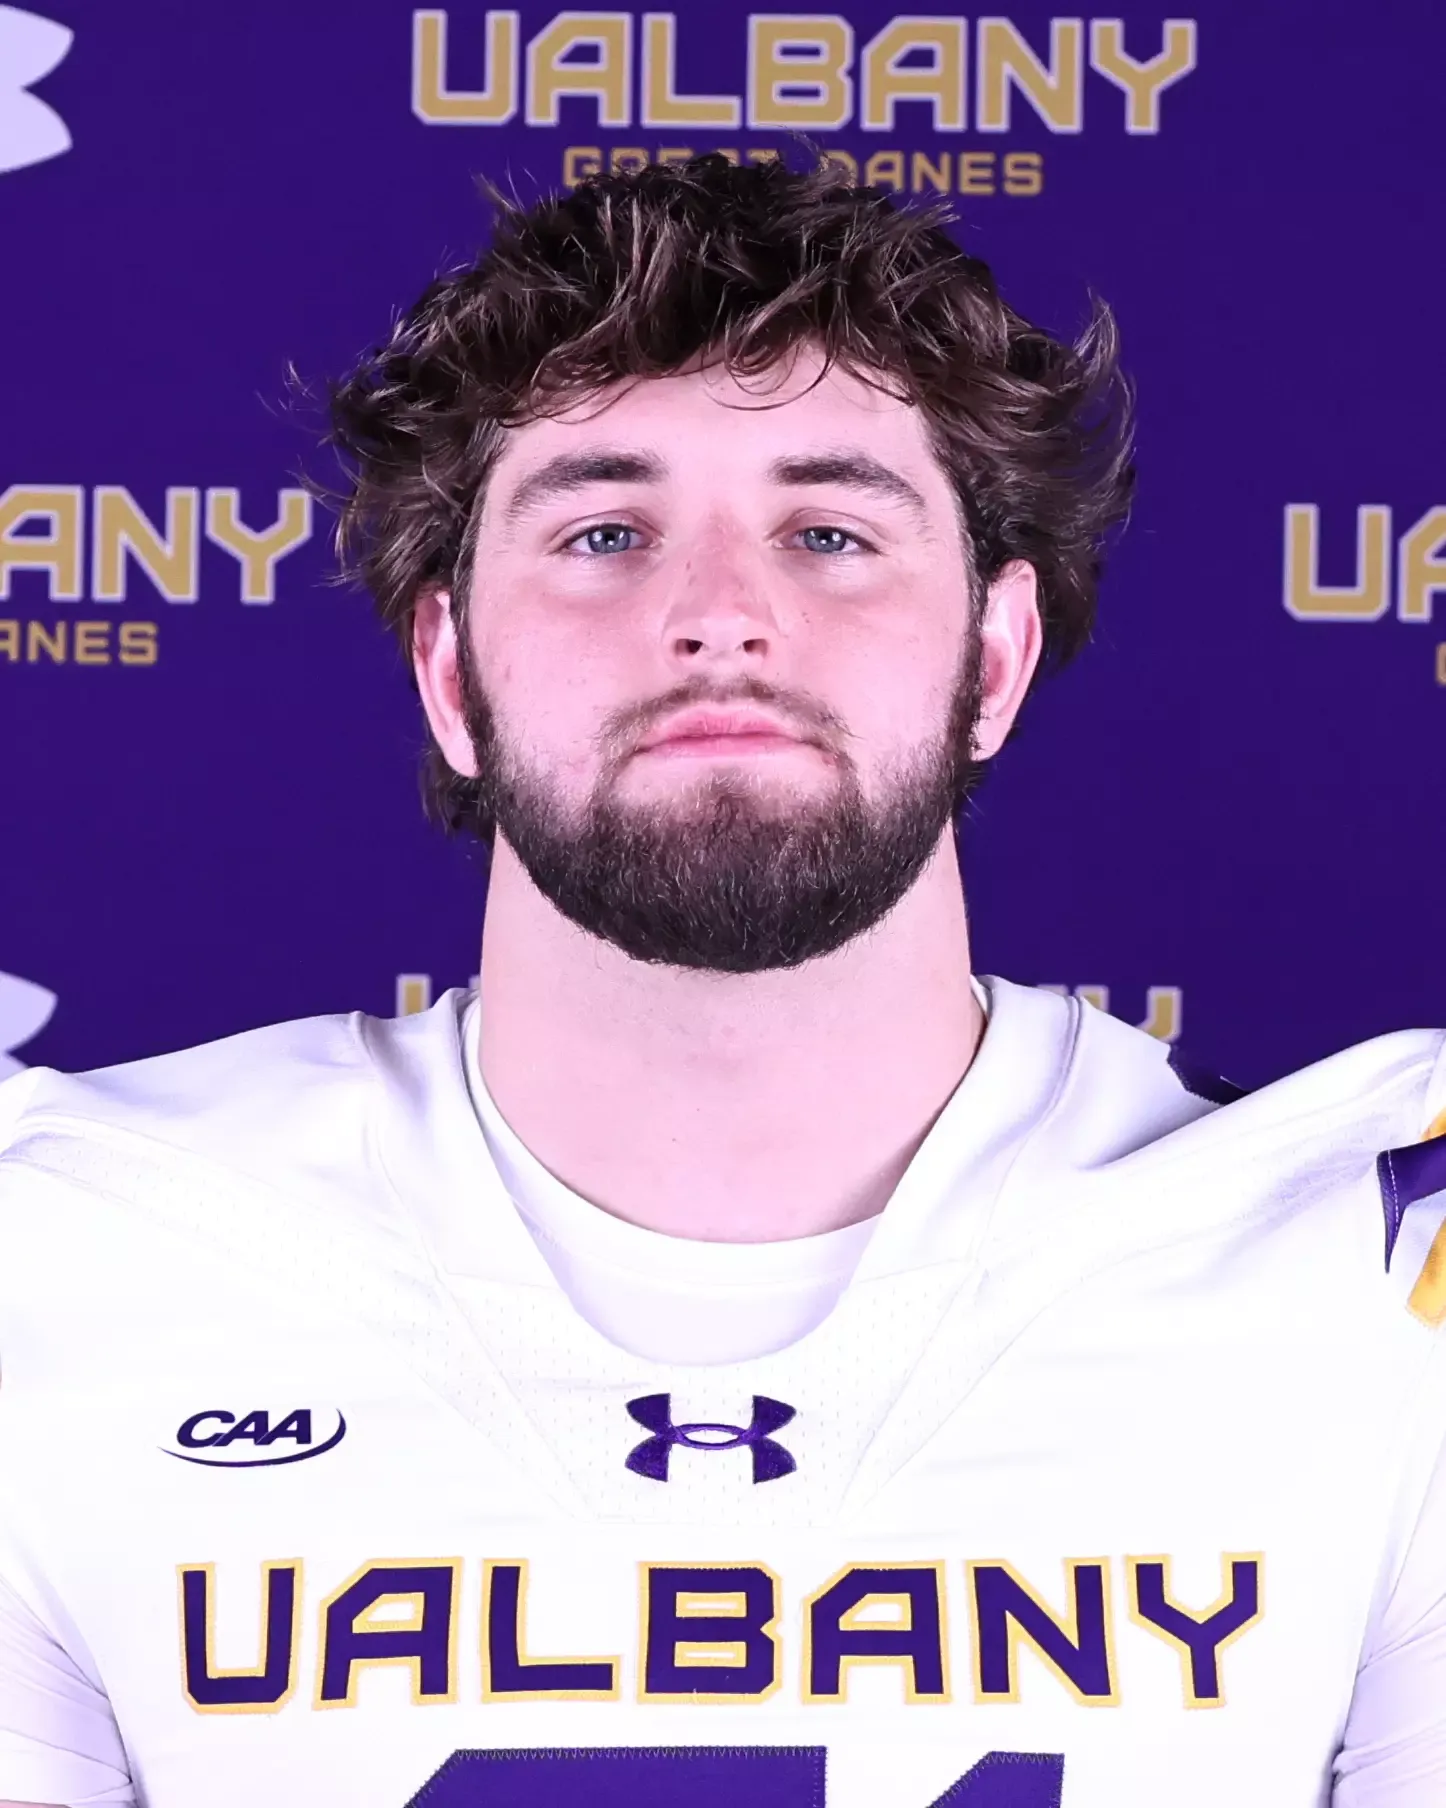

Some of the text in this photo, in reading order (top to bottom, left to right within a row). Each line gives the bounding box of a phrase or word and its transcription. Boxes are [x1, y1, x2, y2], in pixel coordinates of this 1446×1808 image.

[411, 10, 1198, 135] UALBANY
[176, 1408, 312, 1449] CAA
[175, 1551, 1267, 1715] UALBANY
